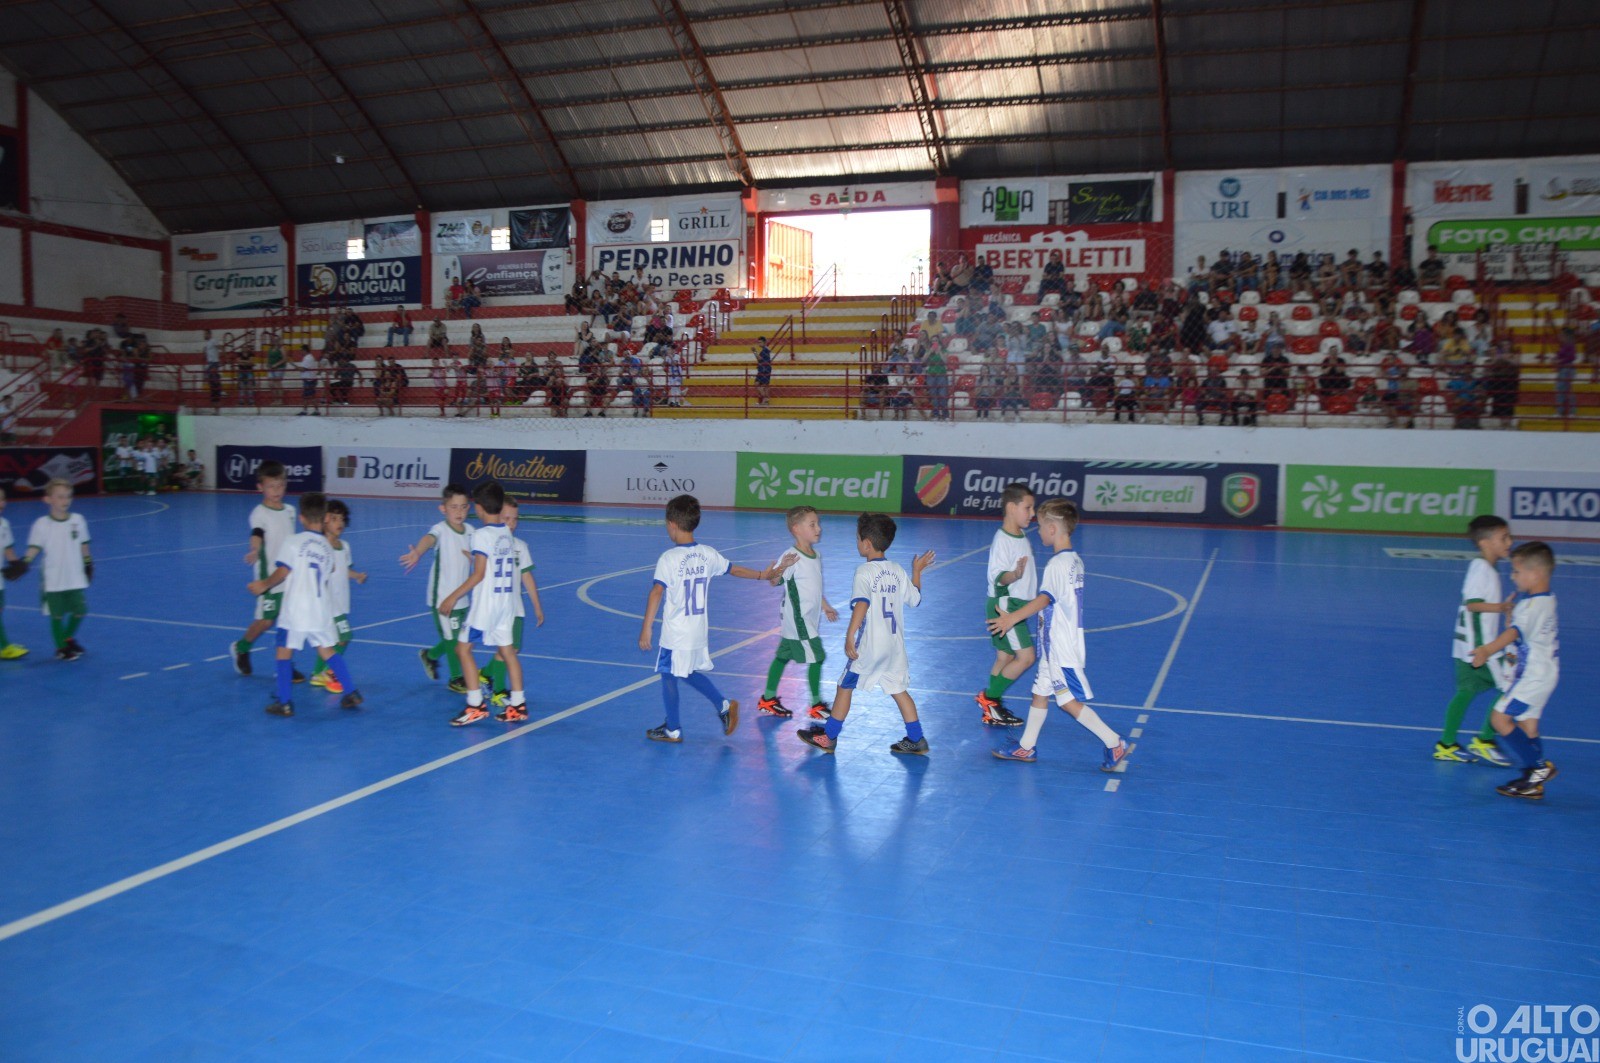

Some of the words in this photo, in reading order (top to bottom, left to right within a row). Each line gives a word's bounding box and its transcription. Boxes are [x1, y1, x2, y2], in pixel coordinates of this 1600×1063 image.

[1210, 201, 1249, 219] URI
[679, 215, 730, 230] GRILL
[983, 231, 1021, 243] MECÂNICA
[1440, 229, 1509, 244] FOTO
[599, 244, 733, 271] PEDRINHO
[346, 264, 360, 280] O
[361, 261, 405, 280] ALTO
[465, 267, 538, 285] Confiança
[194, 273, 278, 298] Grafimax
[339, 279, 405, 295] URUGUAI
[668, 273, 725, 287] Peças
[466, 453, 567, 480] Marathon
[394, 481, 441, 489] Supermercado
[626, 477, 695, 492] LUGANO
[787, 468, 891, 498] Sicredi
[963, 495, 980, 508] de
[980, 496, 1003, 510] fut
[1122, 484, 1194, 503] Sicredi
[1348, 482, 1480, 516] Sicredi
[1514, 490, 1600, 518] BAKO
[684, 577, 707, 616] 10
[882, 597, 896, 634] 4
